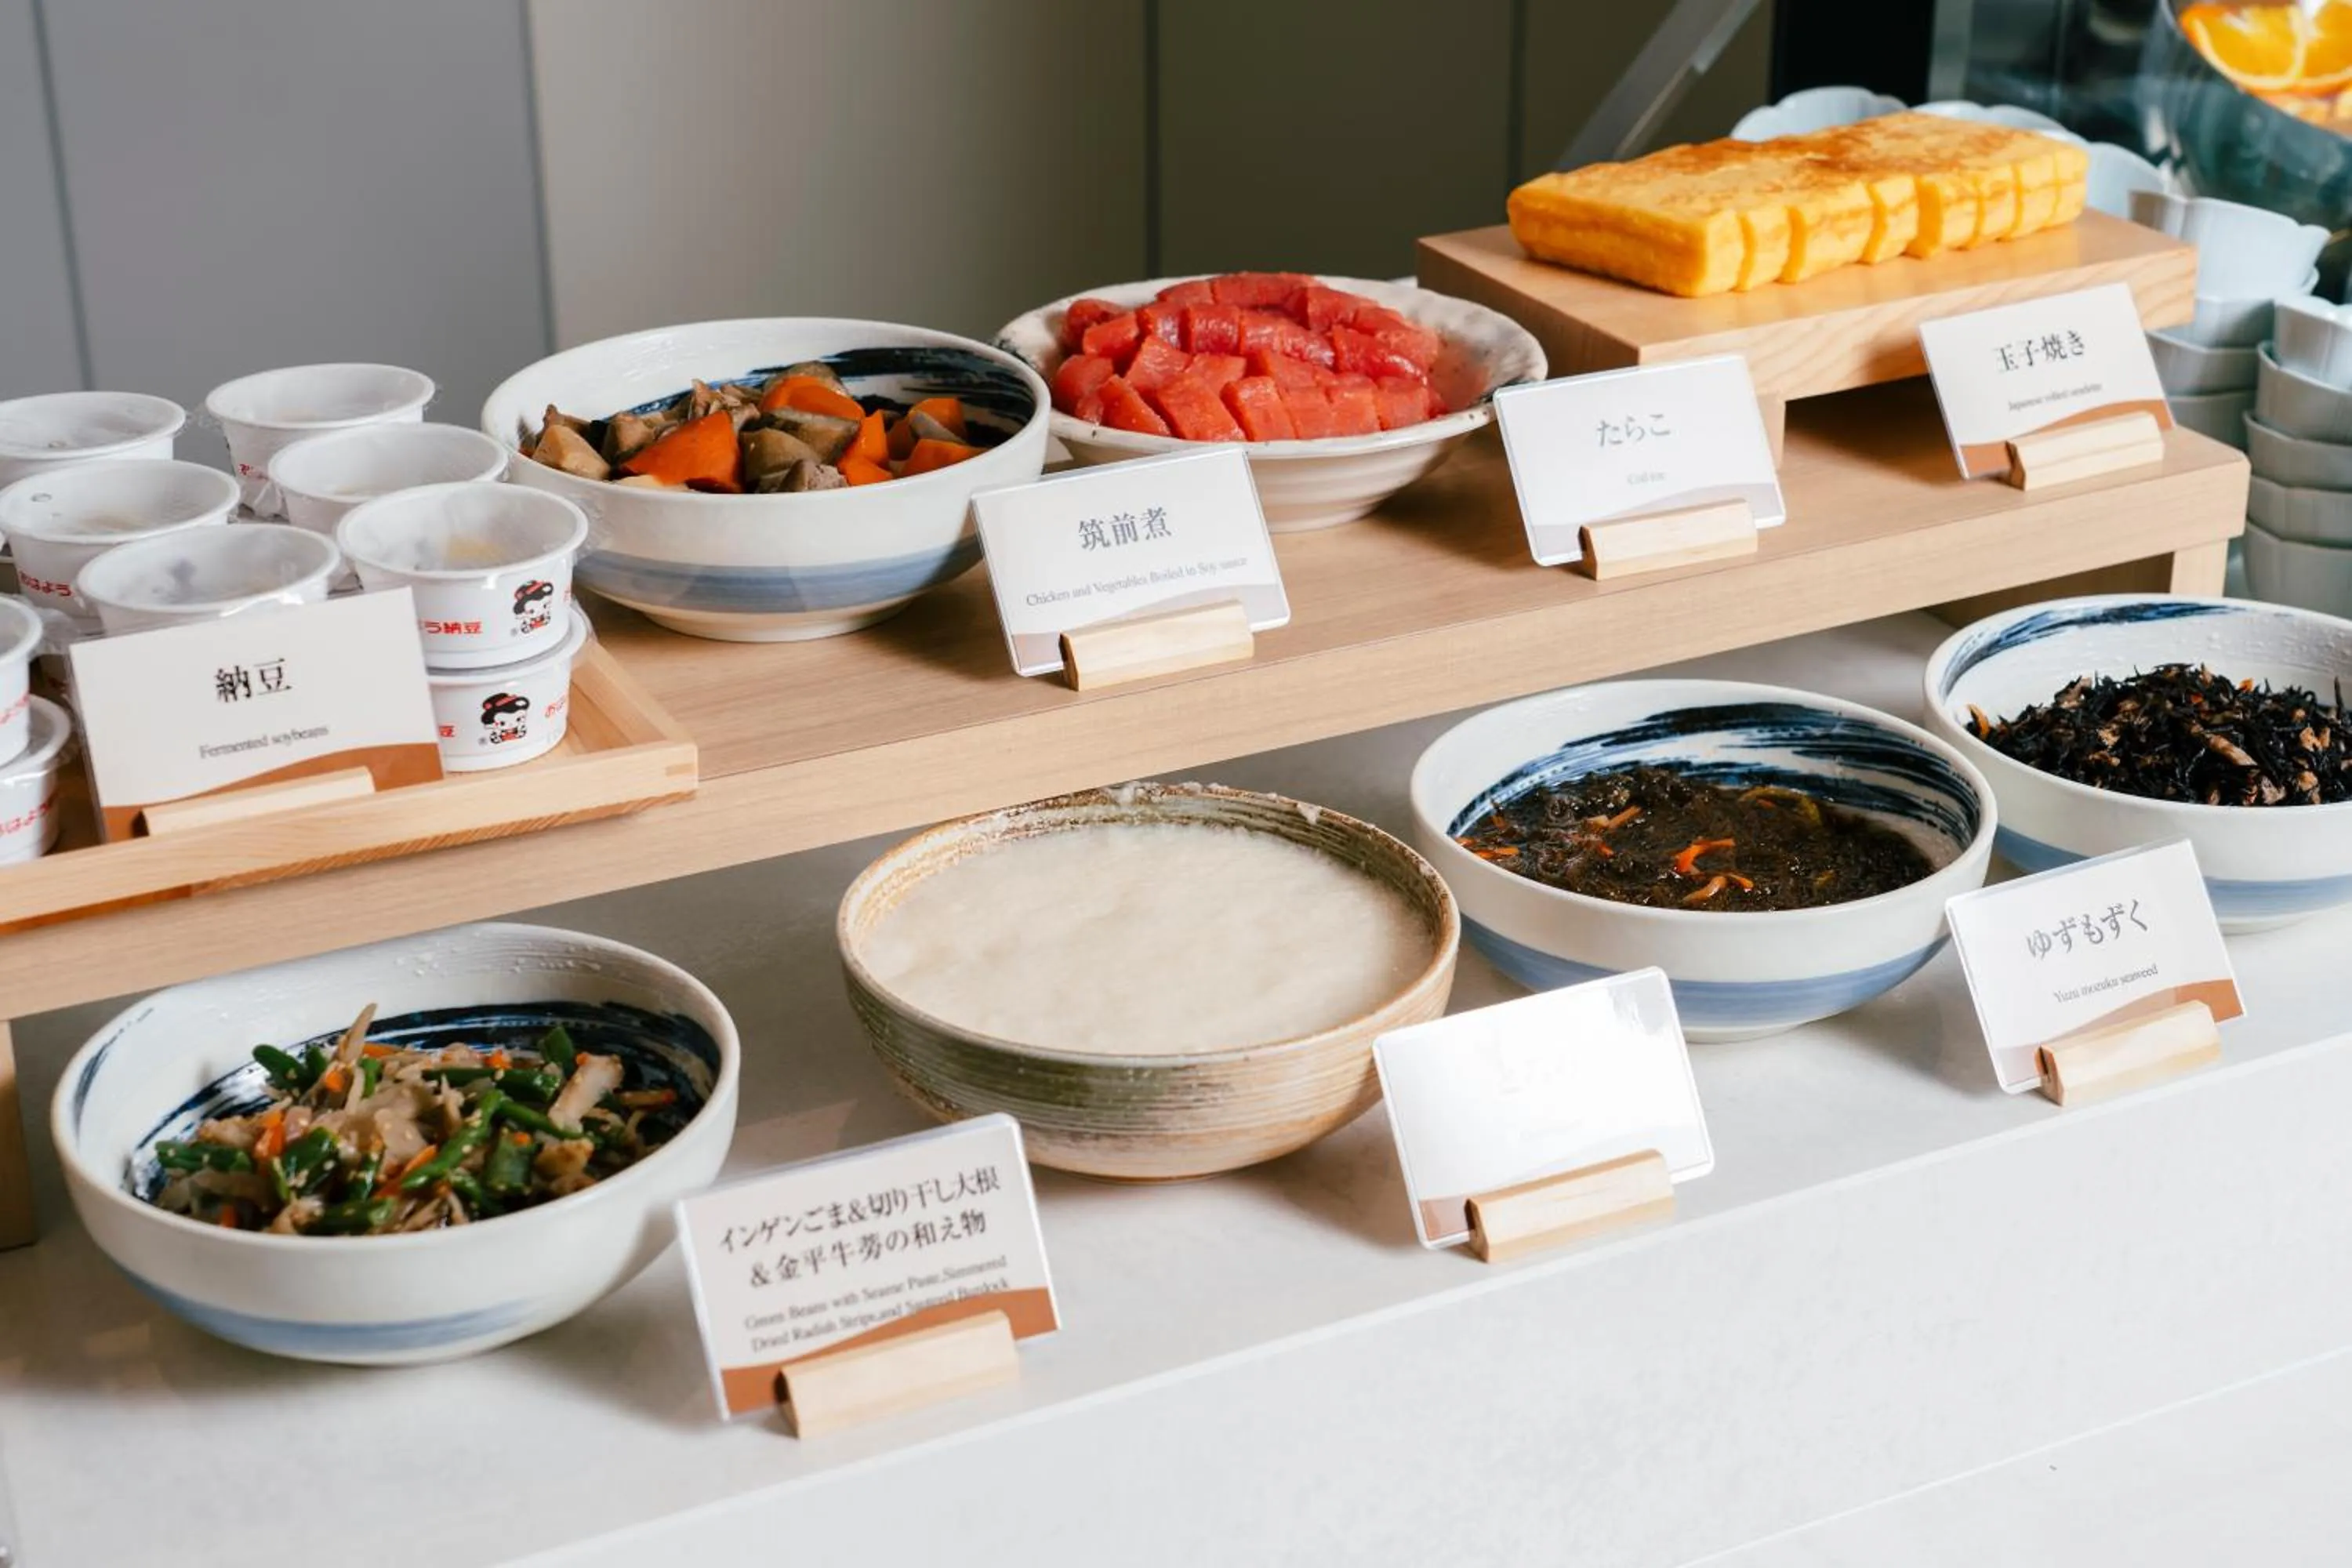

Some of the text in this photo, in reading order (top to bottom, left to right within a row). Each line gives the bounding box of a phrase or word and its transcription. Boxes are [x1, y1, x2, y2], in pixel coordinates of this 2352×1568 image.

[1994, 330, 2085, 372] 玉子焼き
[1597, 412, 1671, 447] たらこ
[1078, 506, 1173, 550] 筑前煮
[1026, 590, 1070, 606] Chicken
[1072, 584, 1092, 598] and
[1093, 575, 1147, 593] Vegetables
[214, 657, 292, 702] 納豆
[199, 726, 329, 759] Fermented soybeans
[2026, 898, 2148, 961] ゆずもずく
[2054, 989, 2079, 1003] Yuzu
[2120, 963, 2158, 984] seaweed
[720, 1165, 1000, 1253] インゲンごま&切り干し大根
[789, 1302, 829, 1319] Beans
